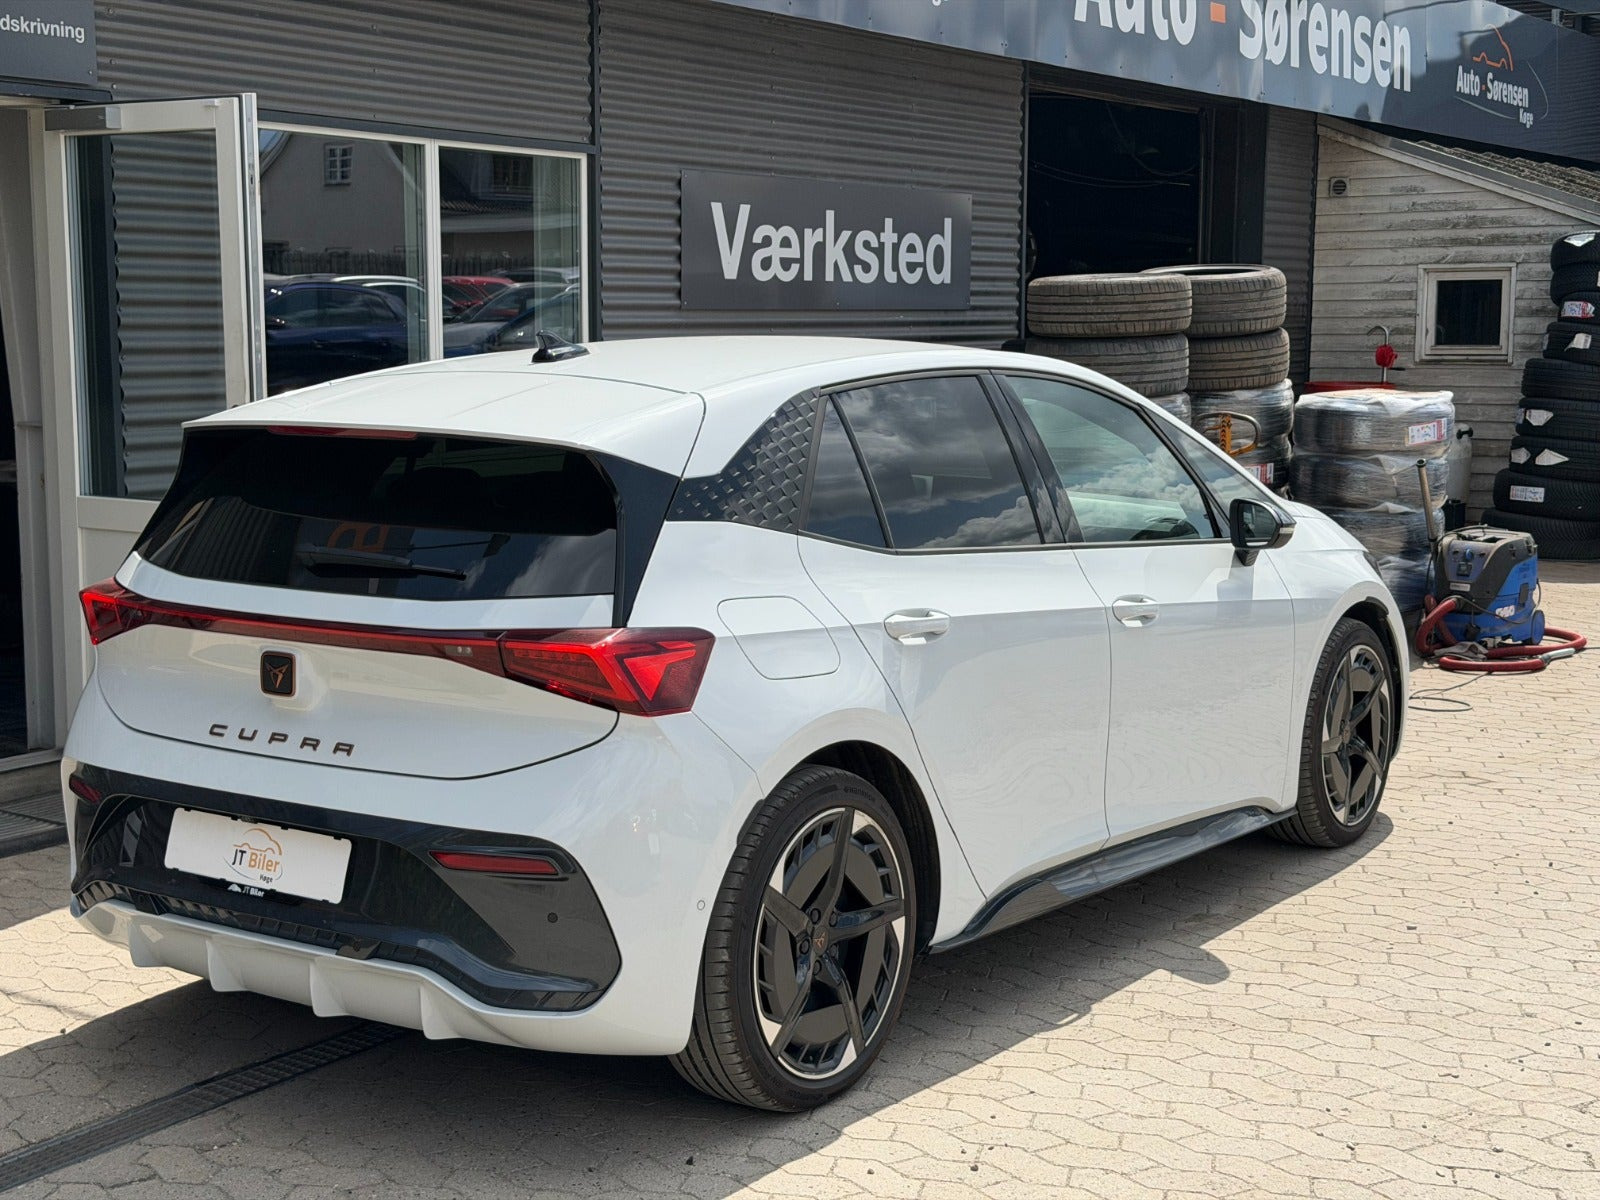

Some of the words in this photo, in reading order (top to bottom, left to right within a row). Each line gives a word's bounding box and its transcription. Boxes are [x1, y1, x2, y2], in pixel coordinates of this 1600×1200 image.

[0, 13, 85, 44] dskrivning
[1073, 0, 1198, 46] uto
[1239, 0, 1412, 93] Sørensen
[1456, 65, 1481, 97] Auto
[1486, 71, 1529, 109] Sørensen
[710, 201, 952, 285] Værksted
[208, 723, 355, 757] CUPRA
[232, 848, 247, 866] JT
[248, 851, 280, 873] Biler
